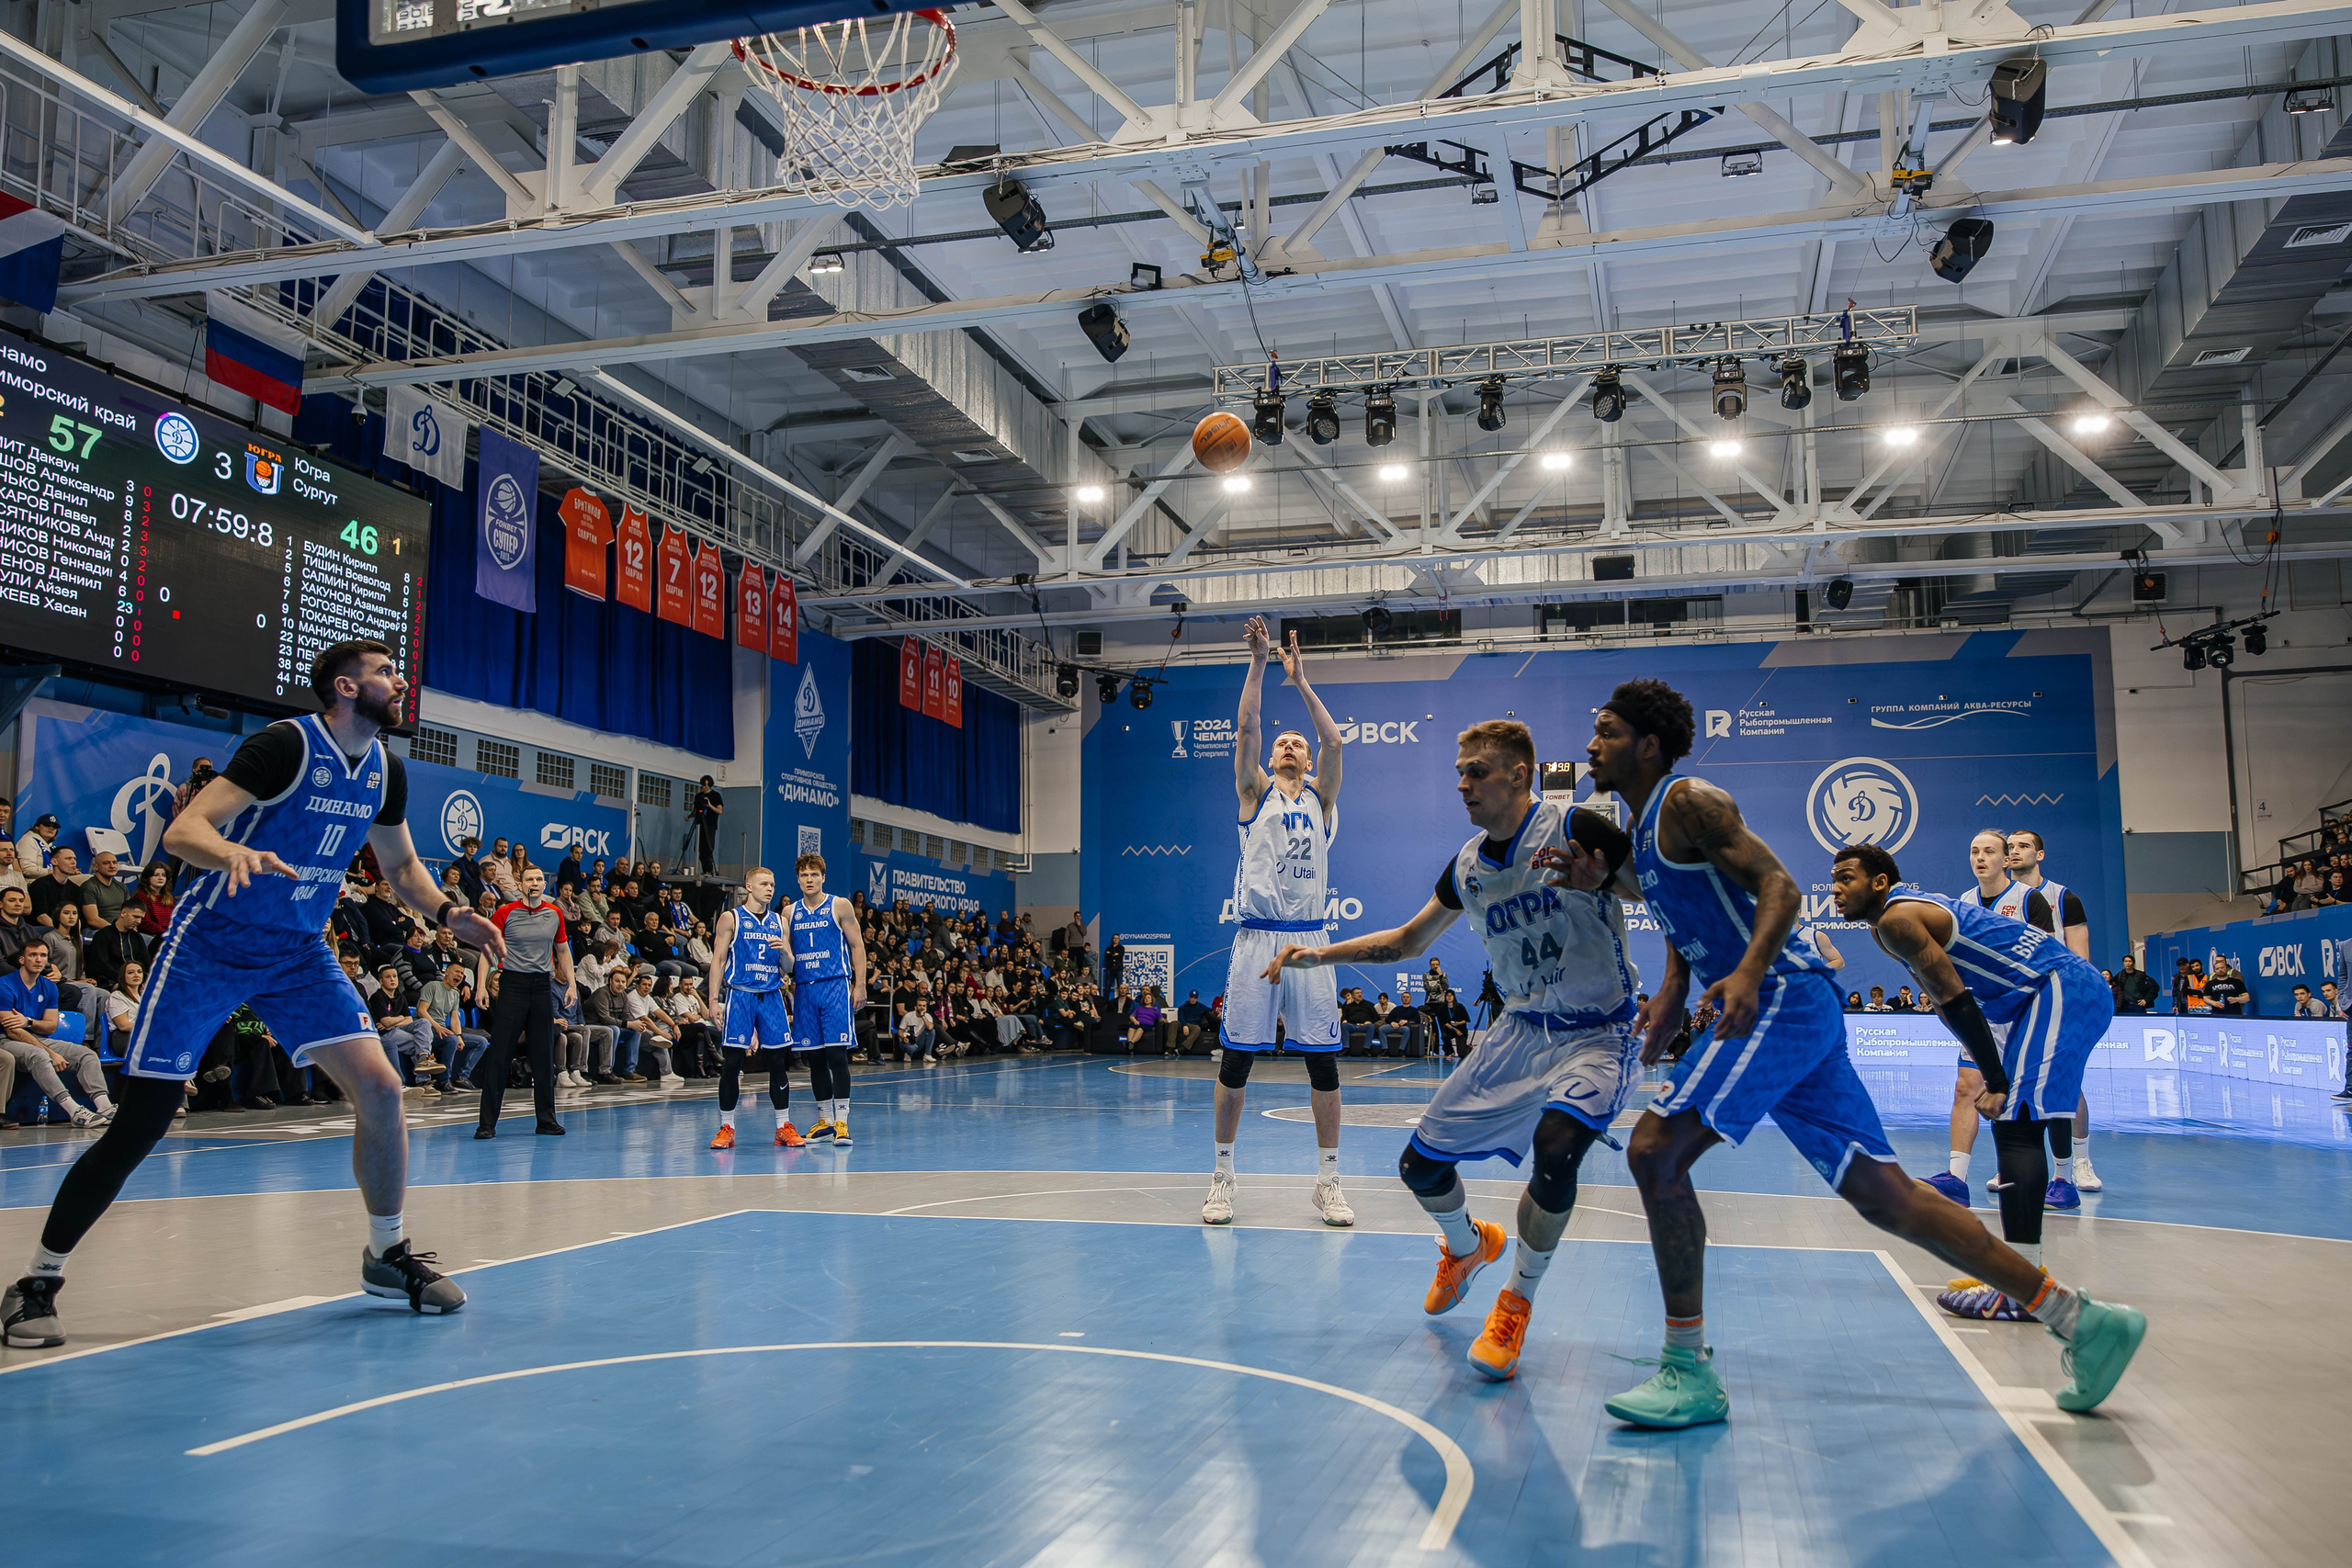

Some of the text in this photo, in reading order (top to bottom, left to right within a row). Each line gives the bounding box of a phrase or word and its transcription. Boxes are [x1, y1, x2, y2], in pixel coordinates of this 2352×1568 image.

[95, 405, 136, 431] край
[49, 414, 103, 460] 57
[248, 443, 281, 462] ЮГРА
[28, 446, 79, 473] Дакаун
[126, 480, 135, 491] 3
[144, 486, 152, 497] 0
[214, 452, 232, 479] 3
[295, 457, 331, 483] Югра
[40, 468, 115, 502] Александр
[125, 495, 133, 506] 9
[143, 501, 150, 512] 3
[293, 479, 338, 505] Сургут
[43, 484, 88, 507] Данил
[124, 510, 131, 521] 8
[141, 516, 149, 527] 2
[53, 502, 96, 526] Павел
[122, 525, 131, 536] 2
[141, 531, 148, 541] 3
[171, 493, 273, 547] 07:59:8
[121, 540, 130, 551] 2
[140, 546, 147, 557] 3
[340, 520, 401, 556] 46 1
[493, 528, 519, 555] СУПЕР
[52, 535, 146, 571] Николай 0 2
[287, 536, 424, 587] 1 БУДИН Кирилл 8 2
[625, 538, 644, 570] 12
[119, 571, 127, 582] 4
[138, 575, 145, 586] 0
[286, 549, 421, 599] 2 ТИШИН Всеволод 0 1
[669, 557, 681, 584] 7
[49, 567, 102, 590] Даниил
[119, 586, 127, 597] 6
[136, 591, 143, 601] 0
[159, 587, 171, 602] 0
[285, 563, 422, 612] 5 САЛМИН Кирилл 5 2
[699, 571, 718, 601] 12
[35, 580, 77, 599] Айзея
[117, 601, 133, 614] 23
[284, 576, 291, 587] 6
[300, 580, 352, 606] ХАКУНОВ
[401, 610, 408, 620] 4
[414, 614, 421, 624] 2
[745, 589, 761, 615] 13
[44, 597, 86, 617] Хасан
[117, 616, 124, 626] 0
[134, 620, 141, 631] 0
[255, 614, 266, 628] 0
[283, 589, 420, 637] 7 РОГОЗЕНКО Андрей 9 2
[776, 602, 792, 628] 14
[281, 604, 420, 649] 9 ТОКАРЕВ Сергей 0 0
[281, 617, 418, 661] 10 МАНИХИН 0 0
[279, 630, 417, 673] 22 8 1
[277, 671, 290, 683] 44
[278, 658, 291, 671] 38
[278, 644, 417, 686] 23 3
[907, 659, 914, 679] 6
[929, 669, 939, 690] 11
[947, 678, 958, 699] 10
[1739, 709, 1775, 718] Русская
[1908, 702, 1960, 712] КОМПАНИЙ
[1964, 701, 2031, 709] АКВА-РЕСУРСЫ
[797, 714, 823, 728] ДИНАМО
[1193, 719, 1231, 731] 2024
[1362, 721, 1419, 745] ВСК
[1739, 716, 1833, 727] Рыбопромышленная
[1739, 728, 1785, 736] Компания
[1193, 750, 1229, 759] Суперлига
[366, 780, 379, 789] BET
[368, 772, 381, 781] FON
[781, 772, 812, 786] СПОРТИВНОЕ
[794, 768, 825, 782] ПРИМОРСКОЕ
[305, 795, 373, 818] ДИНАМО
[777, 783, 840, 808] «ДИНАМО»
[2258, 801, 2267, 812] 4
[316, 823, 347, 857] 10
[571, 826, 610, 856] ВСК
[1285, 837, 1312, 861] 22
[290, 884, 320, 901] КРАЙ
[892, 869, 967, 896] ПРАВИТЕЛЬСТВО
[892, 887, 979, 913] ПРИМОРСКОГО КРАЯ
[794, 920, 829, 931] ДИНАМО
[758, 943, 766, 960] 2
[808, 931, 814, 947] 1
[796, 949, 830, 962] ПРИМОРСКИЙ
[805, 960, 820, 970] КРАЙ
[2277, 943, 2306, 977] ВСК
[745, 963, 778, 974] ПРИМОРСКИЙ
[754, 972, 768, 981] КРАЙ
[1856, 1026, 1897, 1038] Русская
[1856, 1048, 1909, 1057] Компания
